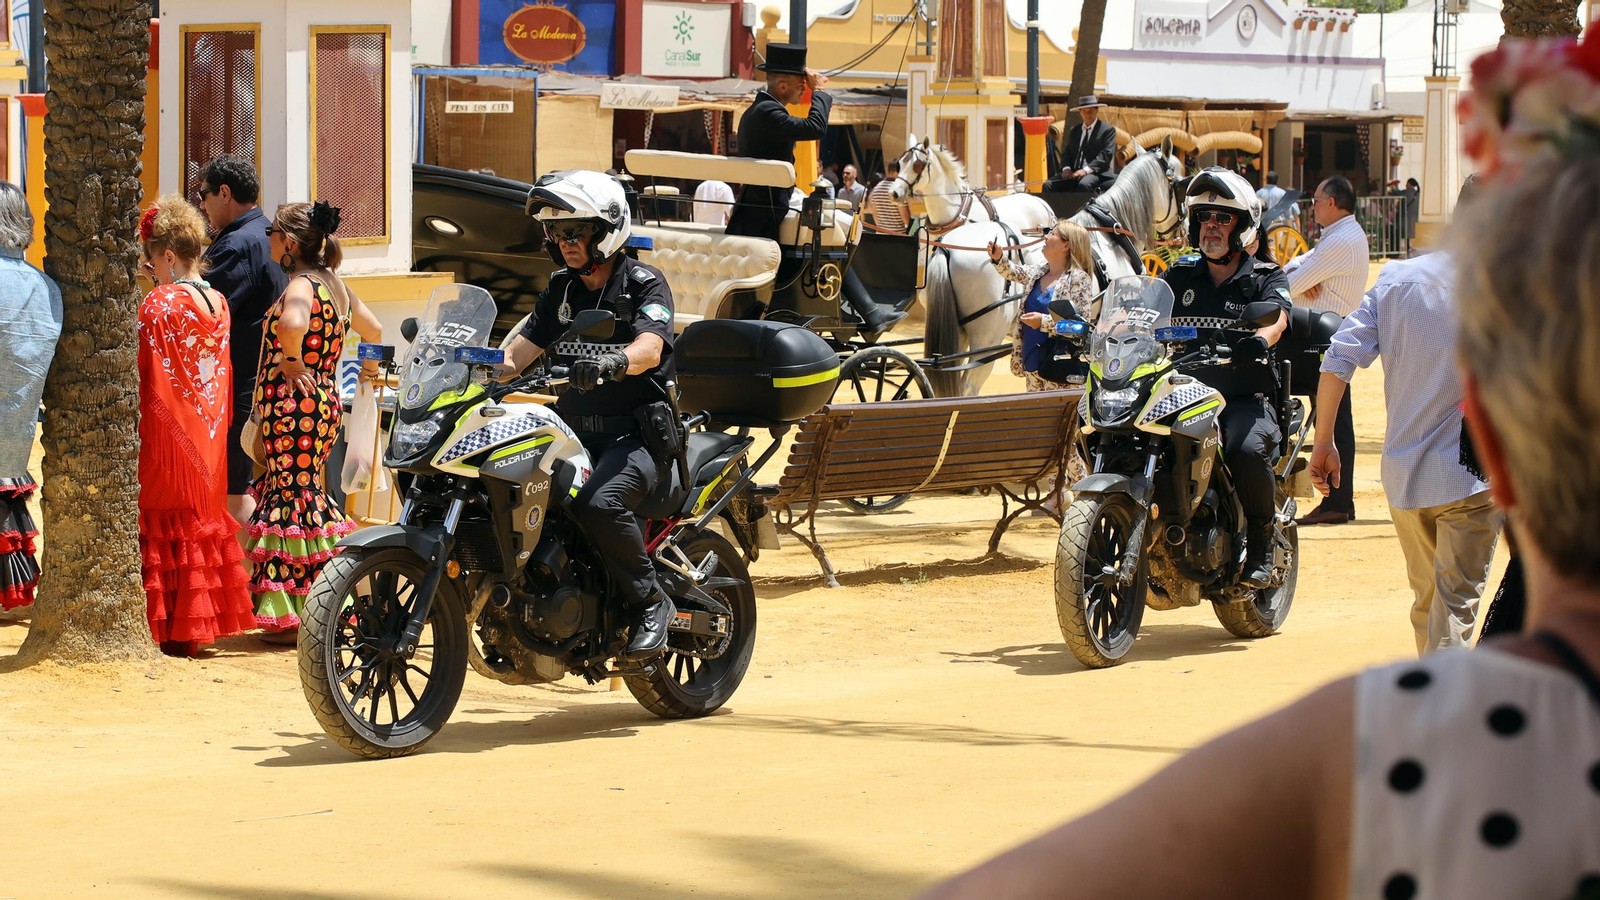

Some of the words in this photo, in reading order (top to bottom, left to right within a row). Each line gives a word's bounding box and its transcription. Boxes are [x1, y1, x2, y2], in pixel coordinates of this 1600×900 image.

[512, 23, 528, 39] La
[530, 25, 577, 40] Moderna
[603, 86, 626, 106] La
[628, 90, 675, 108] Moderna
[1224, 301, 1246, 311] POLIC
[494, 454, 521, 470] POLICIA
[520, 448, 543, 461] LOCAL
[531, 480, 549, 494] 092
